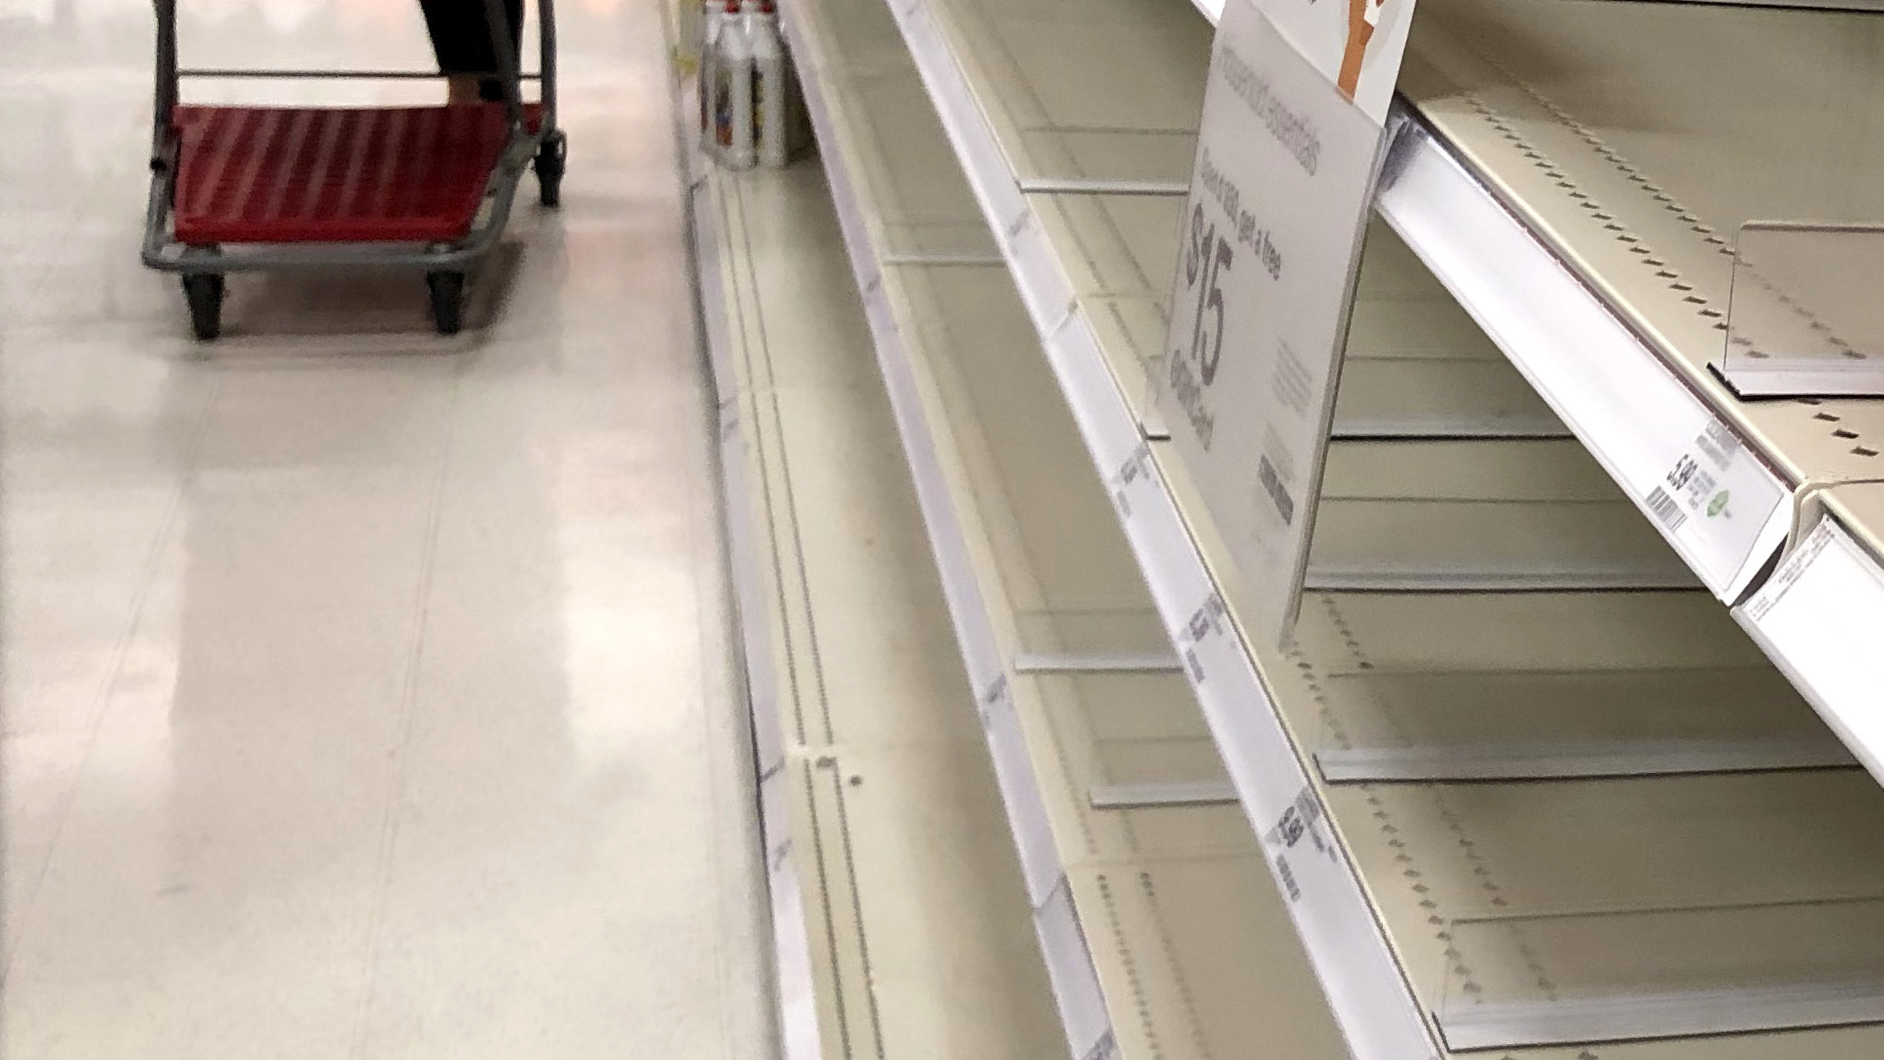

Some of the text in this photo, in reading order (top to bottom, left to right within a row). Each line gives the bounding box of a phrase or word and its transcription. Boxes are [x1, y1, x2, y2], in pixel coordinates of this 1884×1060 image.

[1186, 202, 1234, 387] $15
[1238, 209, 1256, 246] get
[1261, 229, 1281, 282] free
